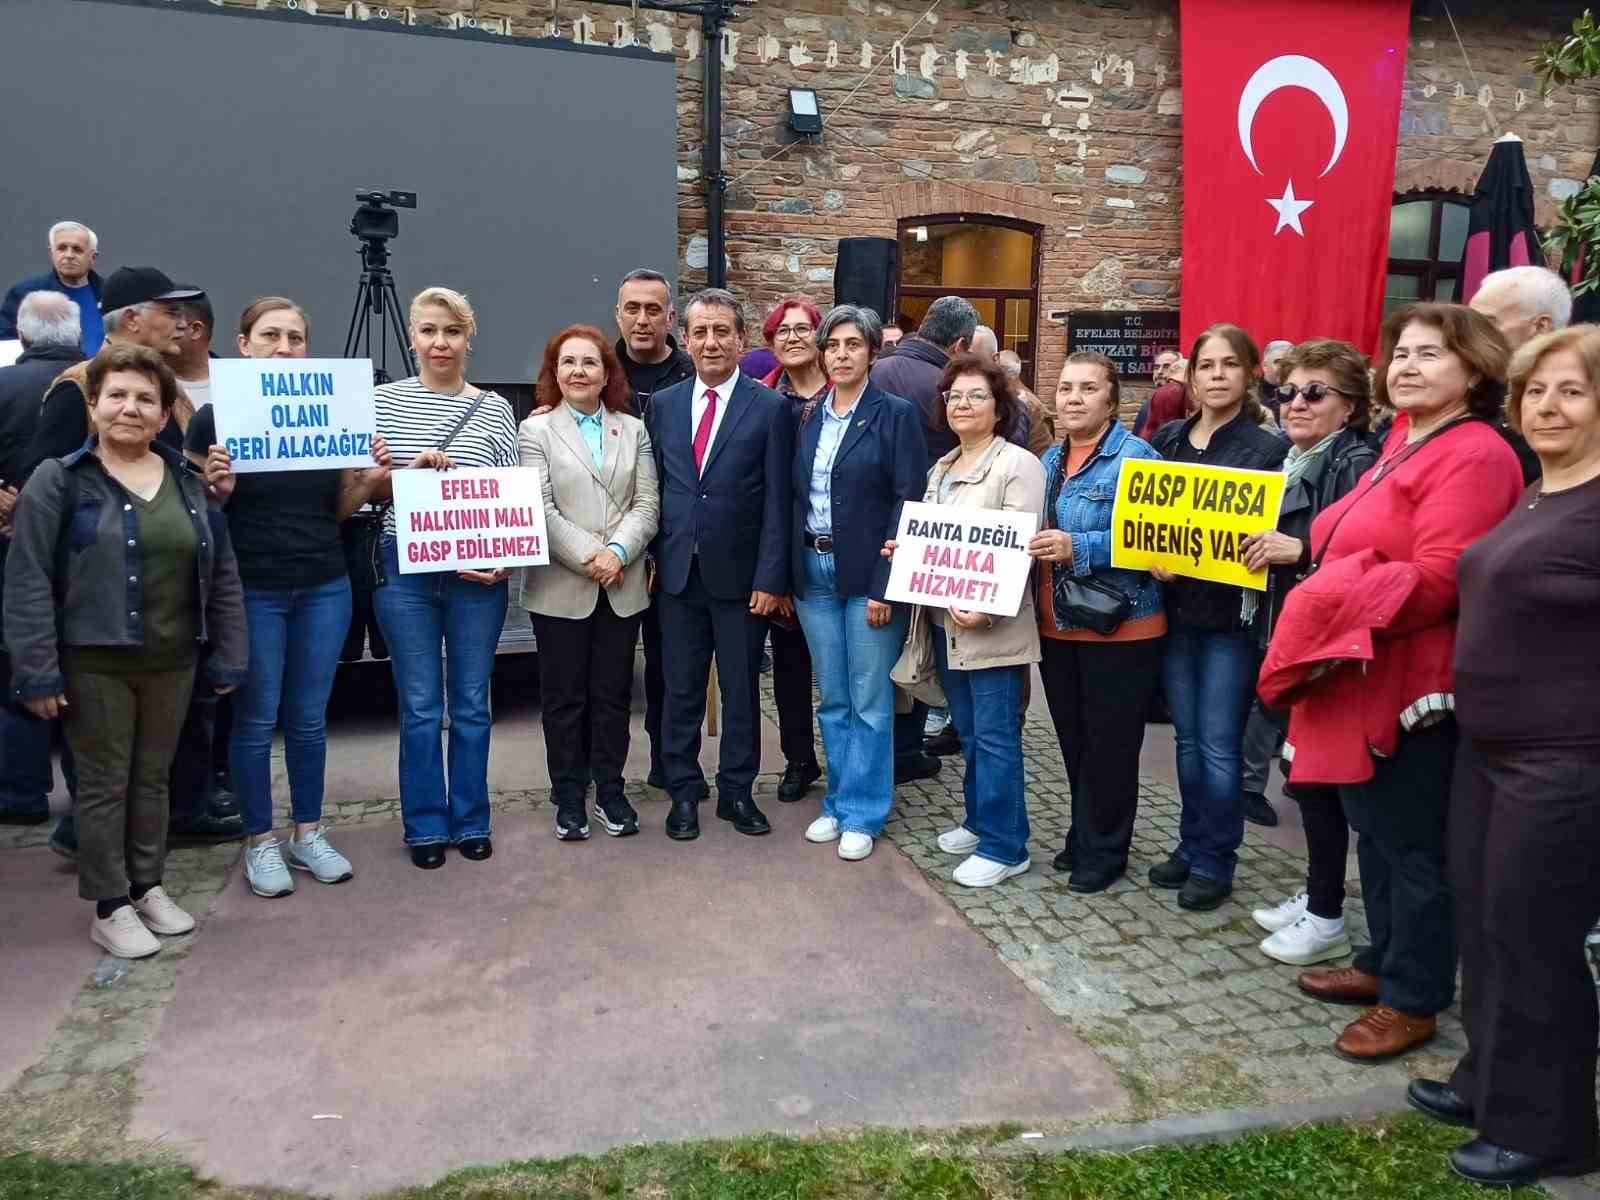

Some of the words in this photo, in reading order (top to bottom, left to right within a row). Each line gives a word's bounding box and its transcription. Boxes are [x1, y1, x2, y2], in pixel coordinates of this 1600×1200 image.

[1076, 329, 1120, 338] EFELER
[261, 373, 333, 396] HALKIN
[271, 404, 329, 428] OLANI
[225, 431, 271, 461] GERİ
[277, 428, 373, 458] ALACAĞIZ!
[441, 479, 500, 500] EFELER
[1128, 471, 1186, 507] GASP
[1192, 477, 1266, 517] VARSA
[410, 509, 490, 532] HALKININ
[495, 507, 533, 527] MALI
[408, 540, 451, 563] GASP
[456, 533, 540, 560] EDİLEMEZ!
[906, 519, 962, 541] RANTA
[968, 524, 1025, 551] DEĞİL,
[1123, 513, 1203, 567] DİRENİŞ
[922, 544, 994, 574] HALKA
[909, 569, 999, 603] HİZMET!
